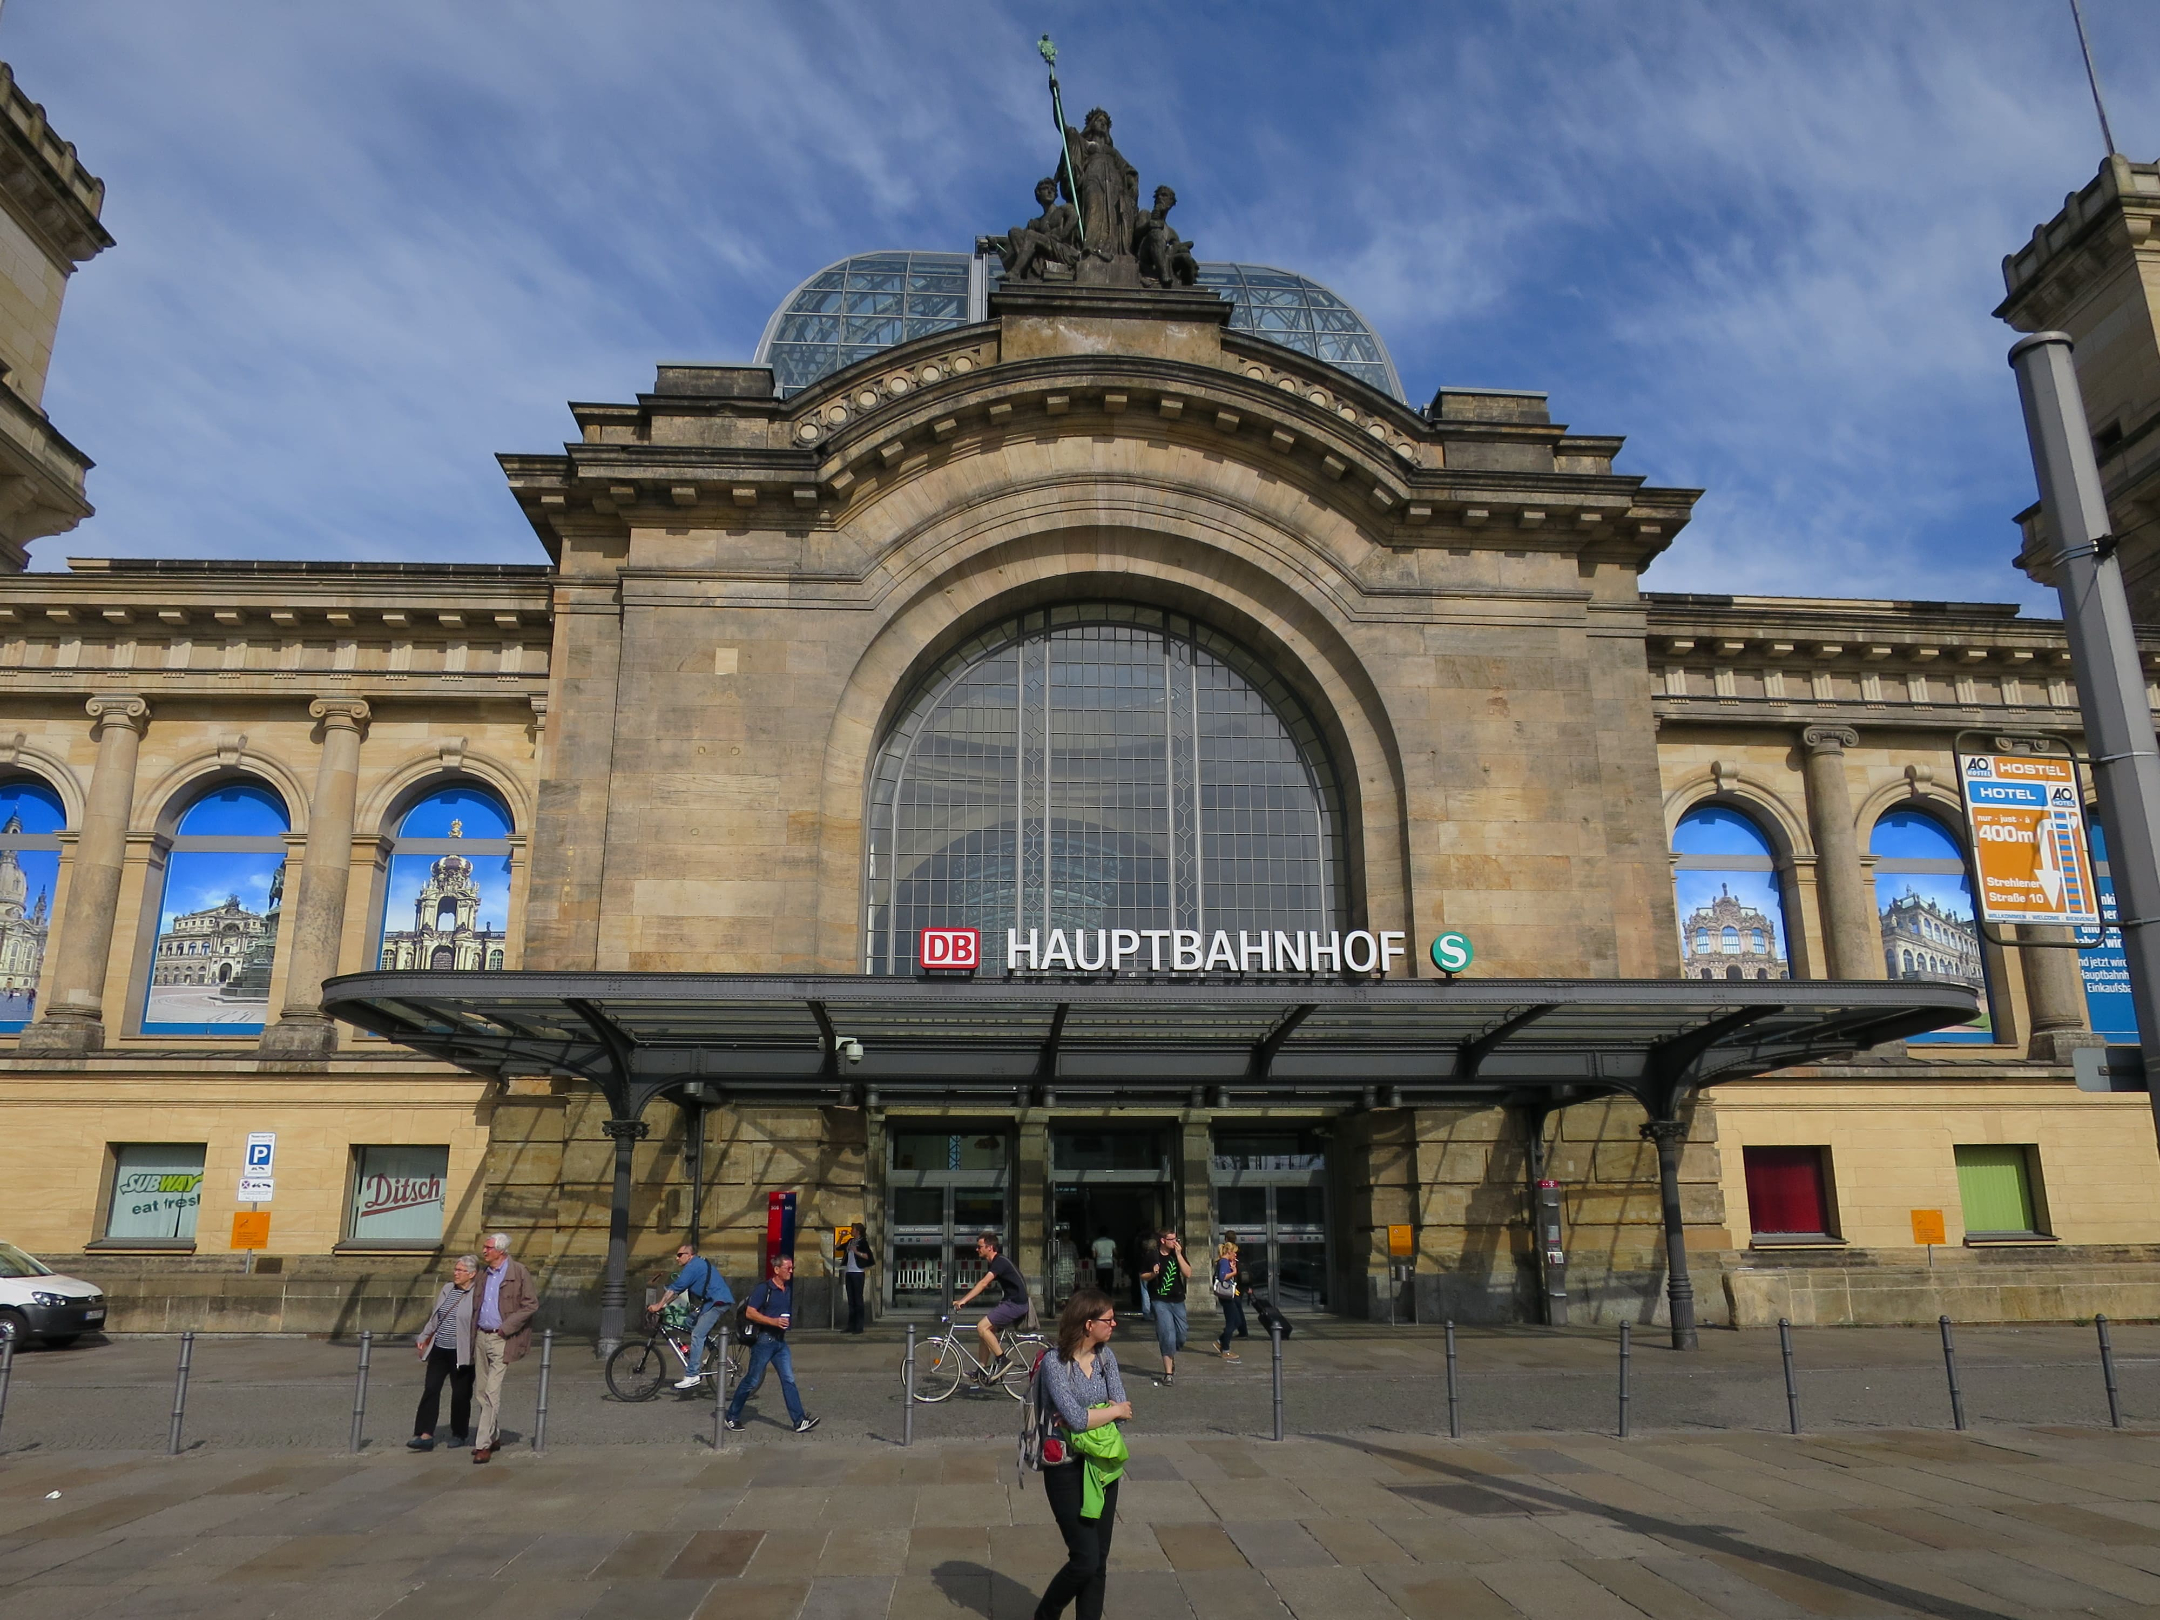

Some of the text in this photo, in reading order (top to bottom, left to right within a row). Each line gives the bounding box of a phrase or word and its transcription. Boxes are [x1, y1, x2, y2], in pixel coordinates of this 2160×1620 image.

[1999, 763, 2066, 777] HOSTEL
[1980, 787, 2036, 800] HOTEL
[2000, 814, 2017, 823] just
[1979, 825, 2035, 843] 400m
[1987, 876, 2041, 888] Strehlener
[1989, 892, 2044, 903] Straße 10
[928, 935, 972, 961] DB
[1007, 928, 1405, 972] HAUPTBAHNHOF
[1439, 935, 1467, 968] S
[2090, 957, 2110, 968] jetzt
[252, 1146, 268, 1164] P
[119, 1172, 204, 1195] SUBWAY
[365, 1173, 440, 1209] Ditsch
[132, 1200, 159, 1214] eat
